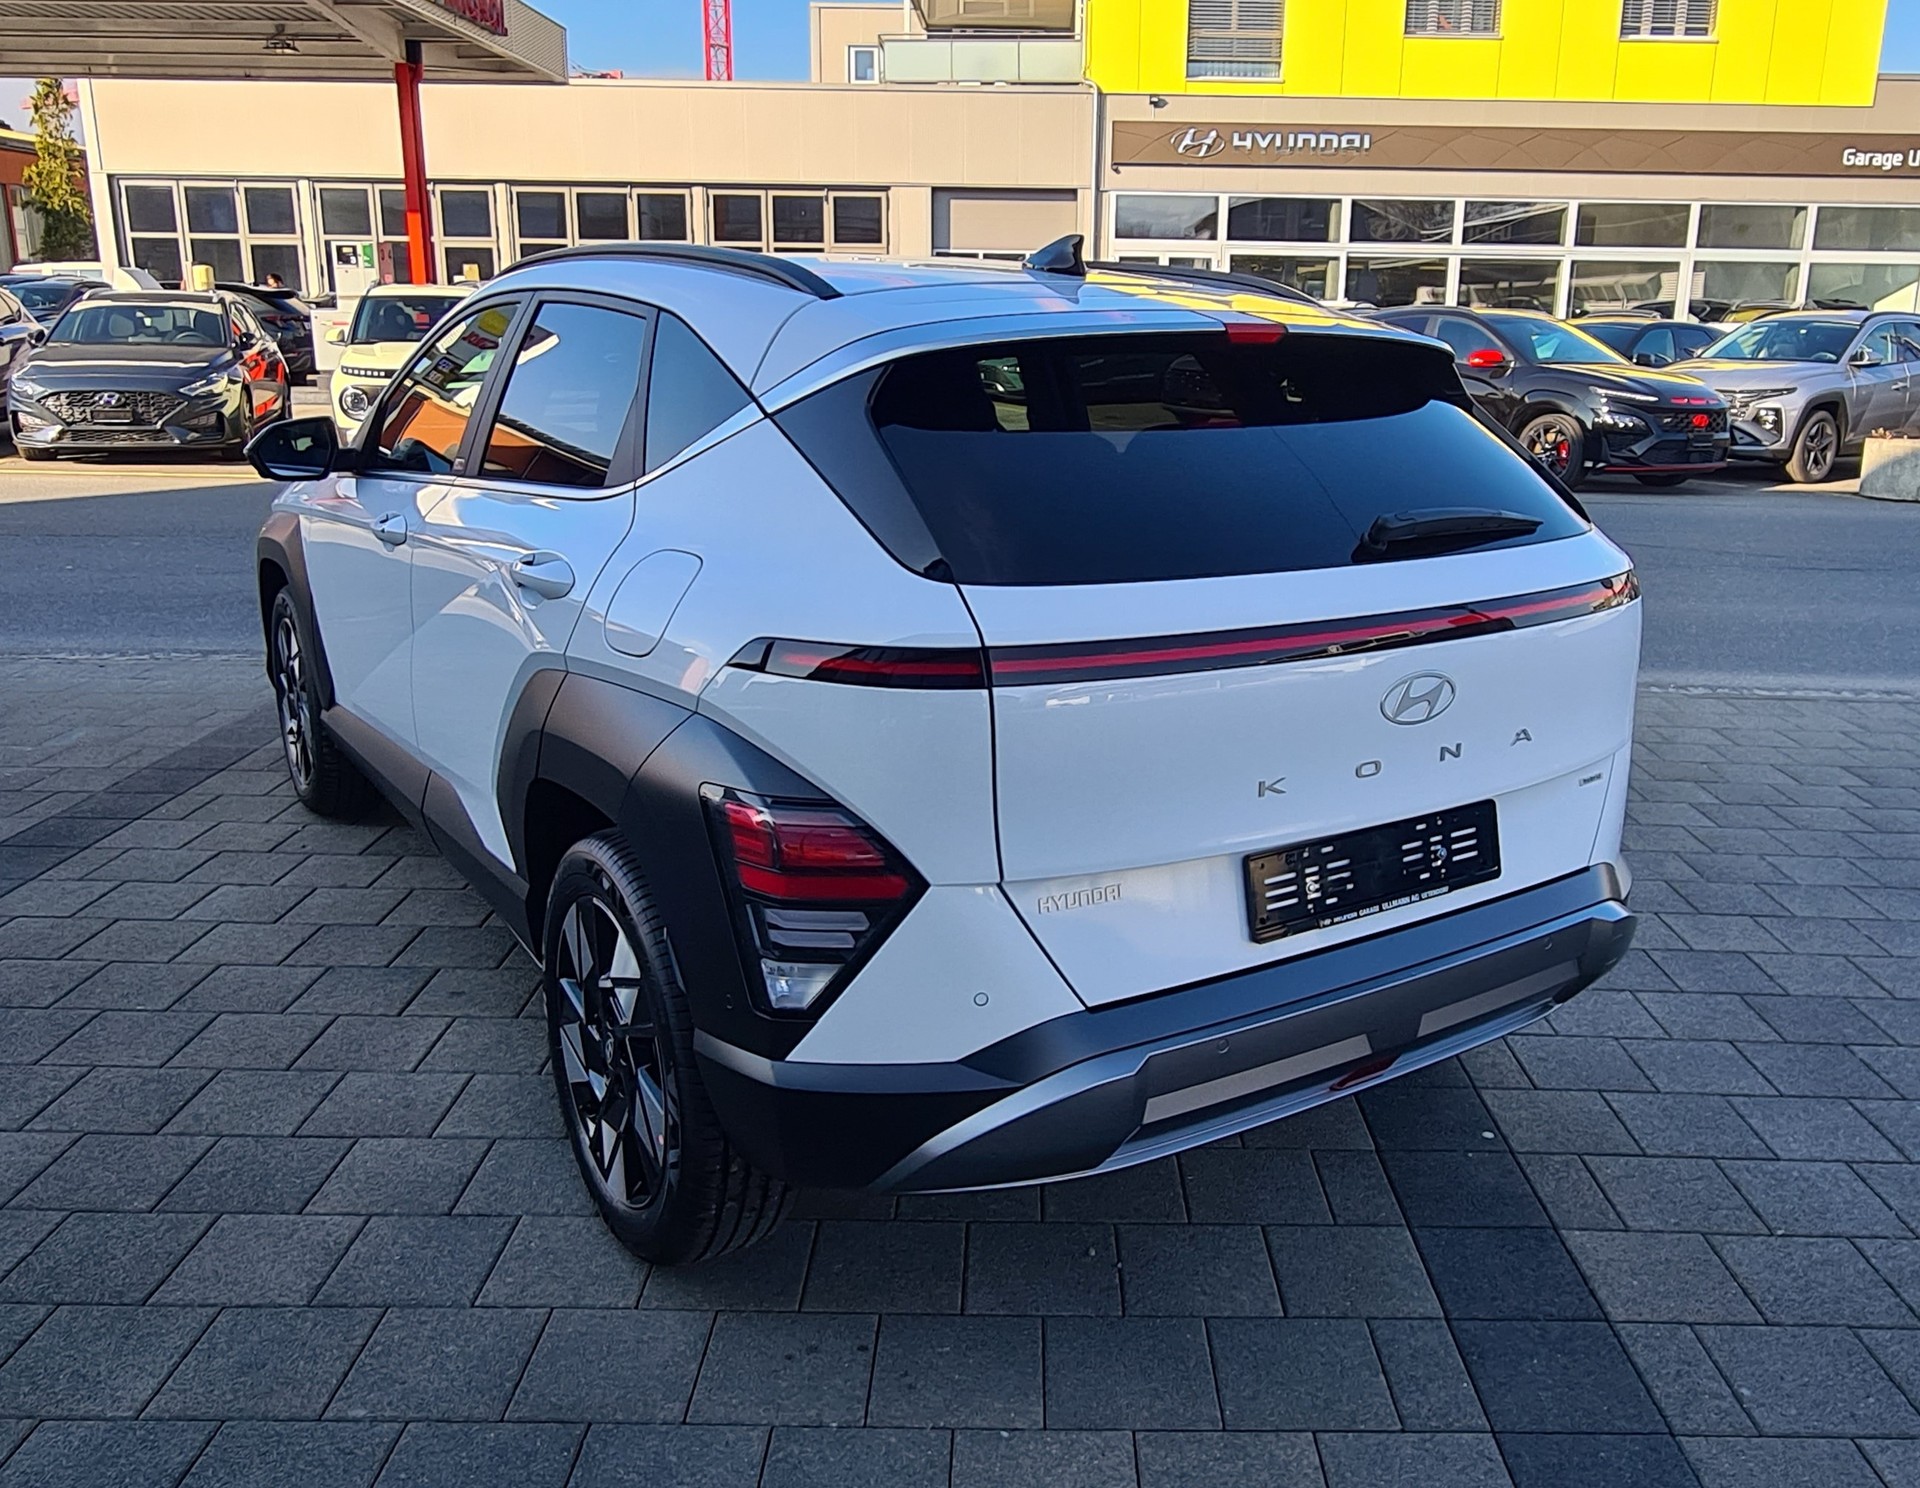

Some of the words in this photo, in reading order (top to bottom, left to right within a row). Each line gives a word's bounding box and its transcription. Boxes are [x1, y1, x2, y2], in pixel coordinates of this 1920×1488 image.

[1232, 131, 1371, 155] HYUNDAI
[1842, 148, 1904, 171] Garage
[1037, 883, 1122, 914] HYUNDAI
